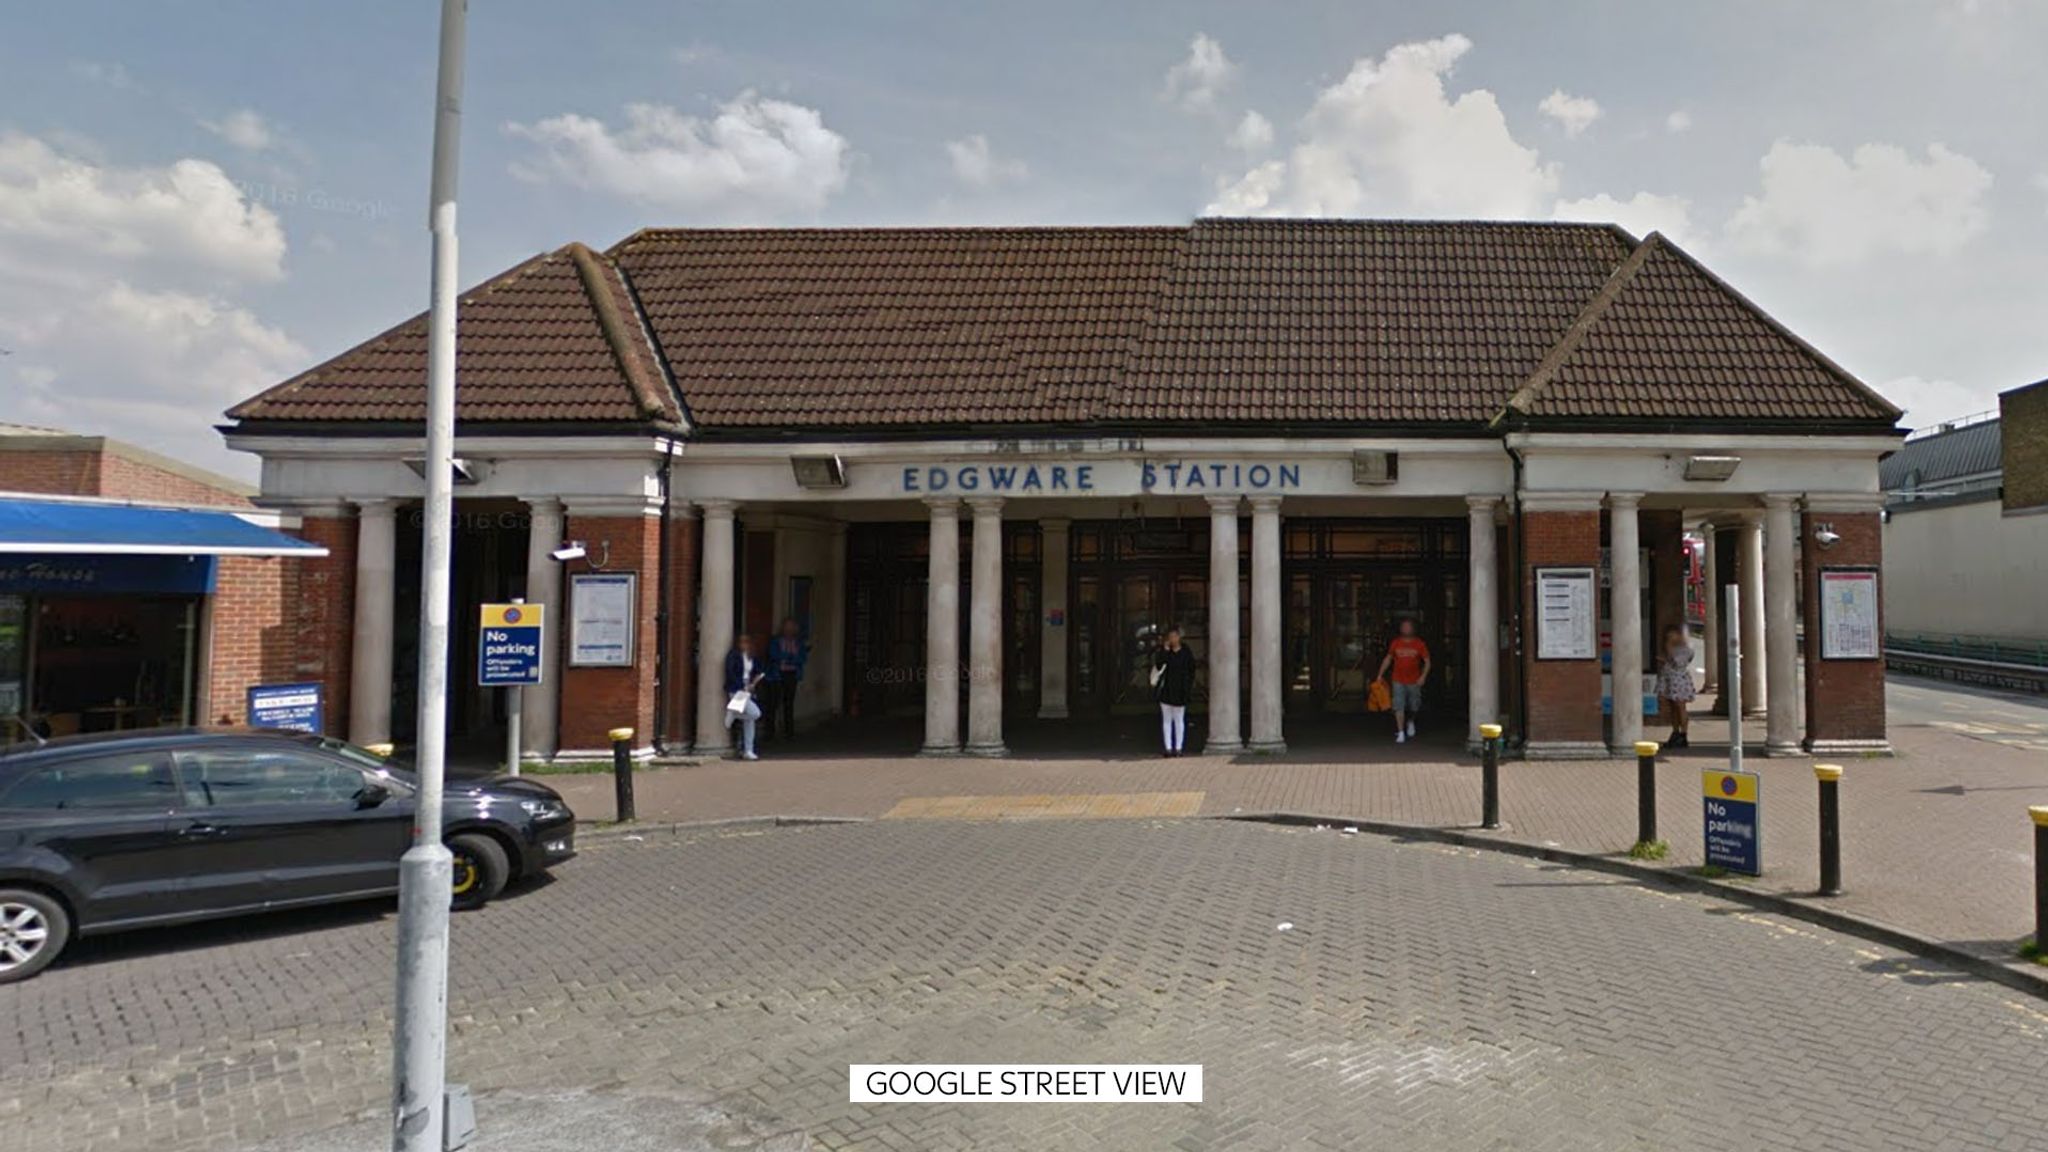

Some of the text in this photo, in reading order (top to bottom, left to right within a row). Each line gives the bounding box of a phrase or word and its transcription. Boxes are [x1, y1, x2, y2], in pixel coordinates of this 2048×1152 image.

[903, 464, 1300, 491] EDGWARE STATION
[486, 631, 508, 642] No
[486, 643, 536, 657] parking
[1708, 801, 1726, 816] No
